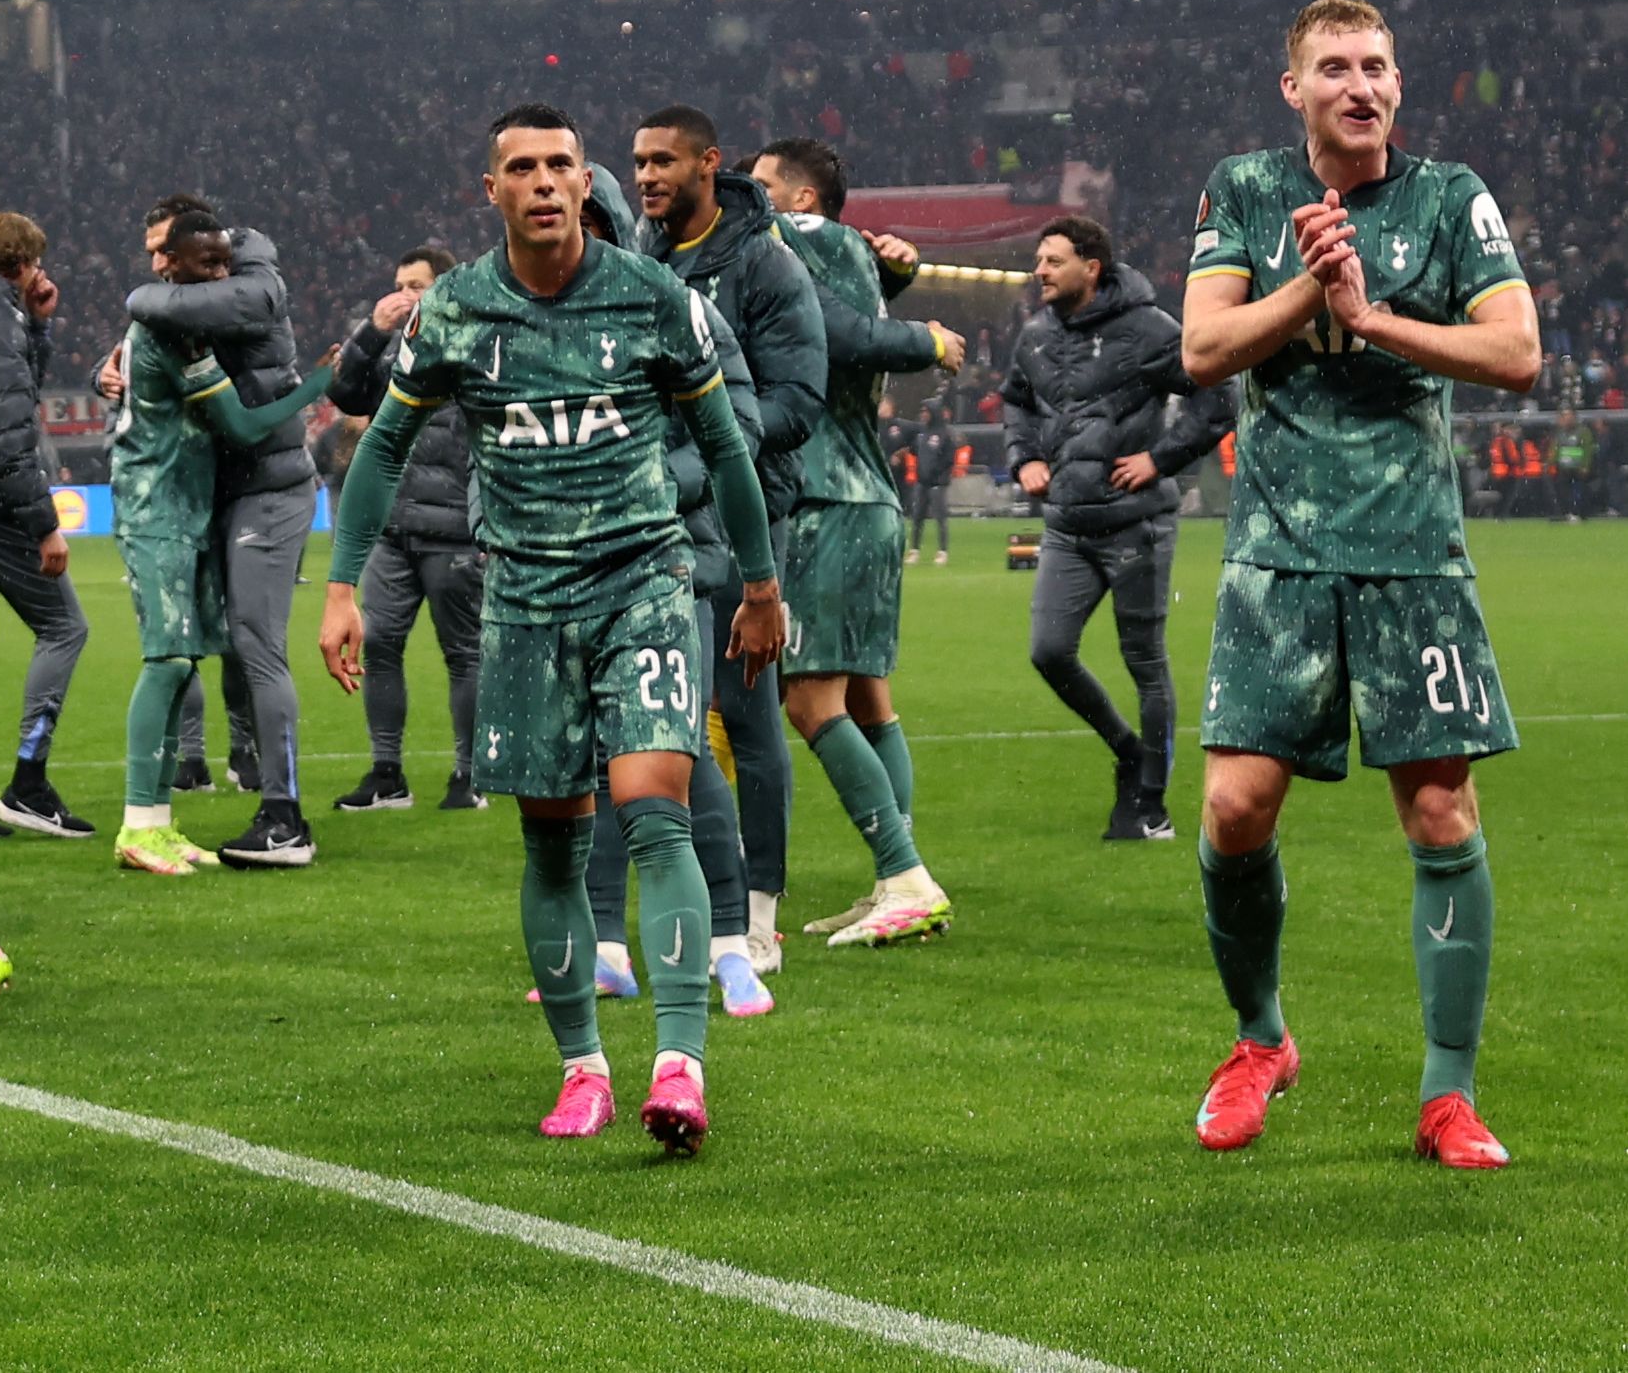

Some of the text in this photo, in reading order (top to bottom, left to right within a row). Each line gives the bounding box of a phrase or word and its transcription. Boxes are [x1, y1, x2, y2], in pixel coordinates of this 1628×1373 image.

[499, 395, 630, 447] AIA
[637, 648, 688, 711] 23
[1421, 644, 1471, 713] 21
